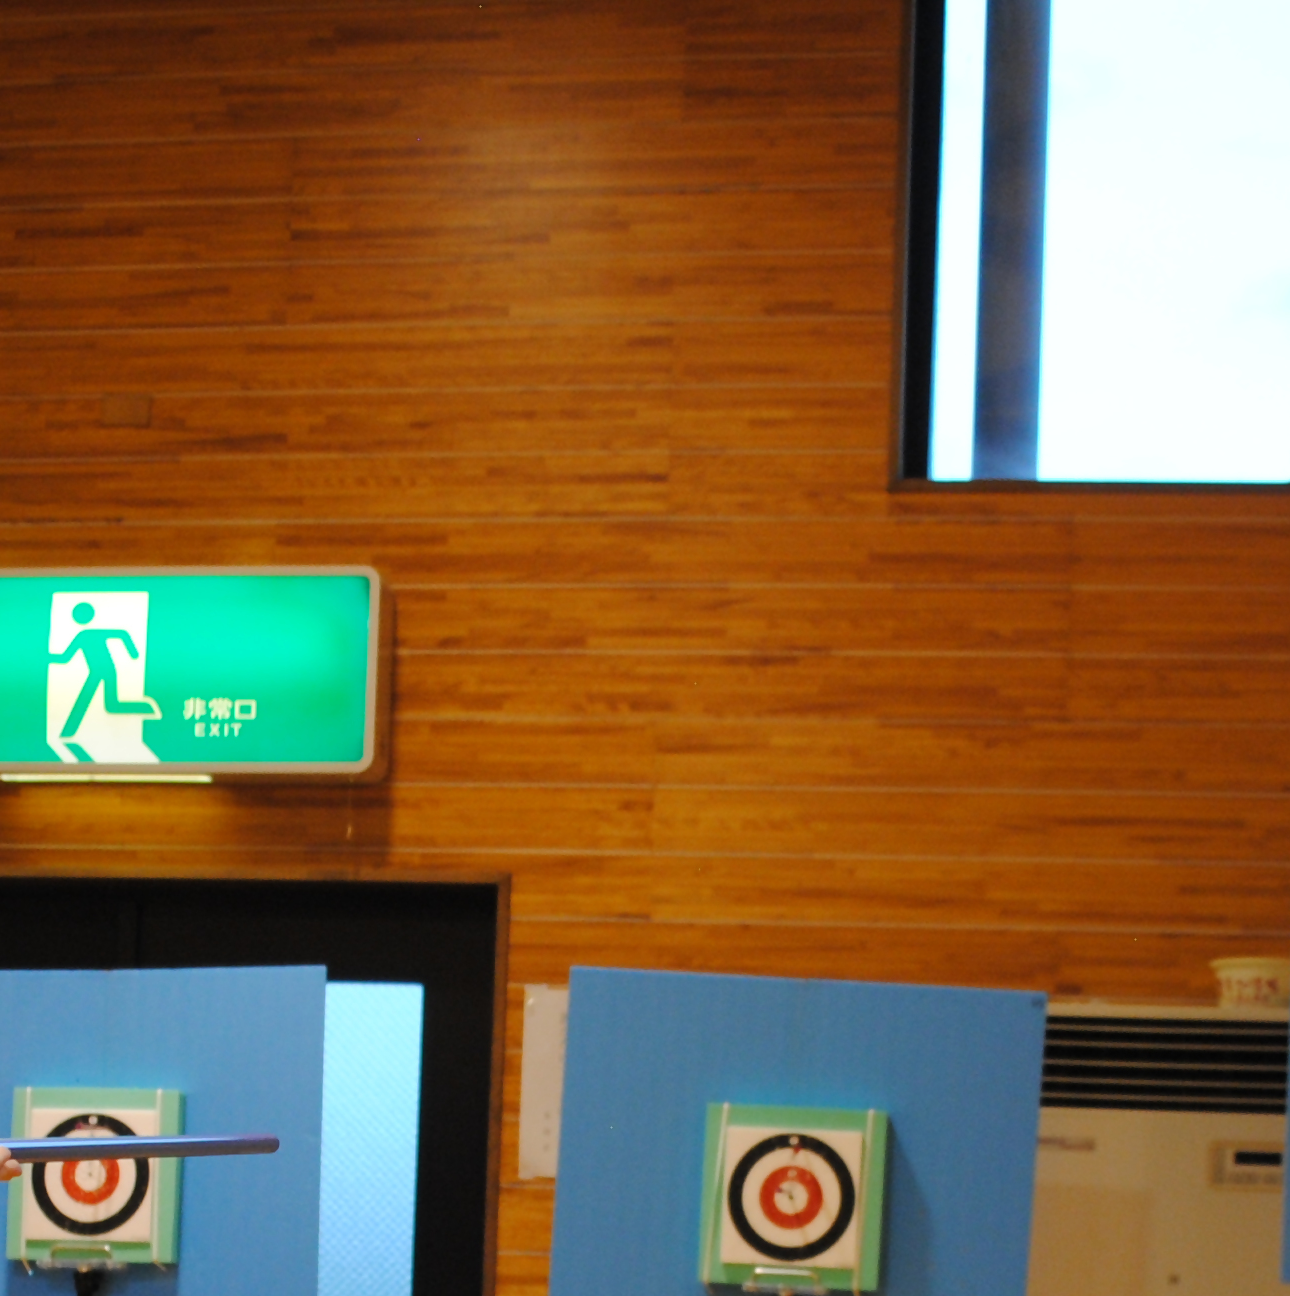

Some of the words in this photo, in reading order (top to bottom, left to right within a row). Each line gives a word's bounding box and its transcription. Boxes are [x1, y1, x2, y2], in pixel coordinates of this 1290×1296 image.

[183, 697, 257, 720] 非常口
[194, 722, 243, 737] EXIT
